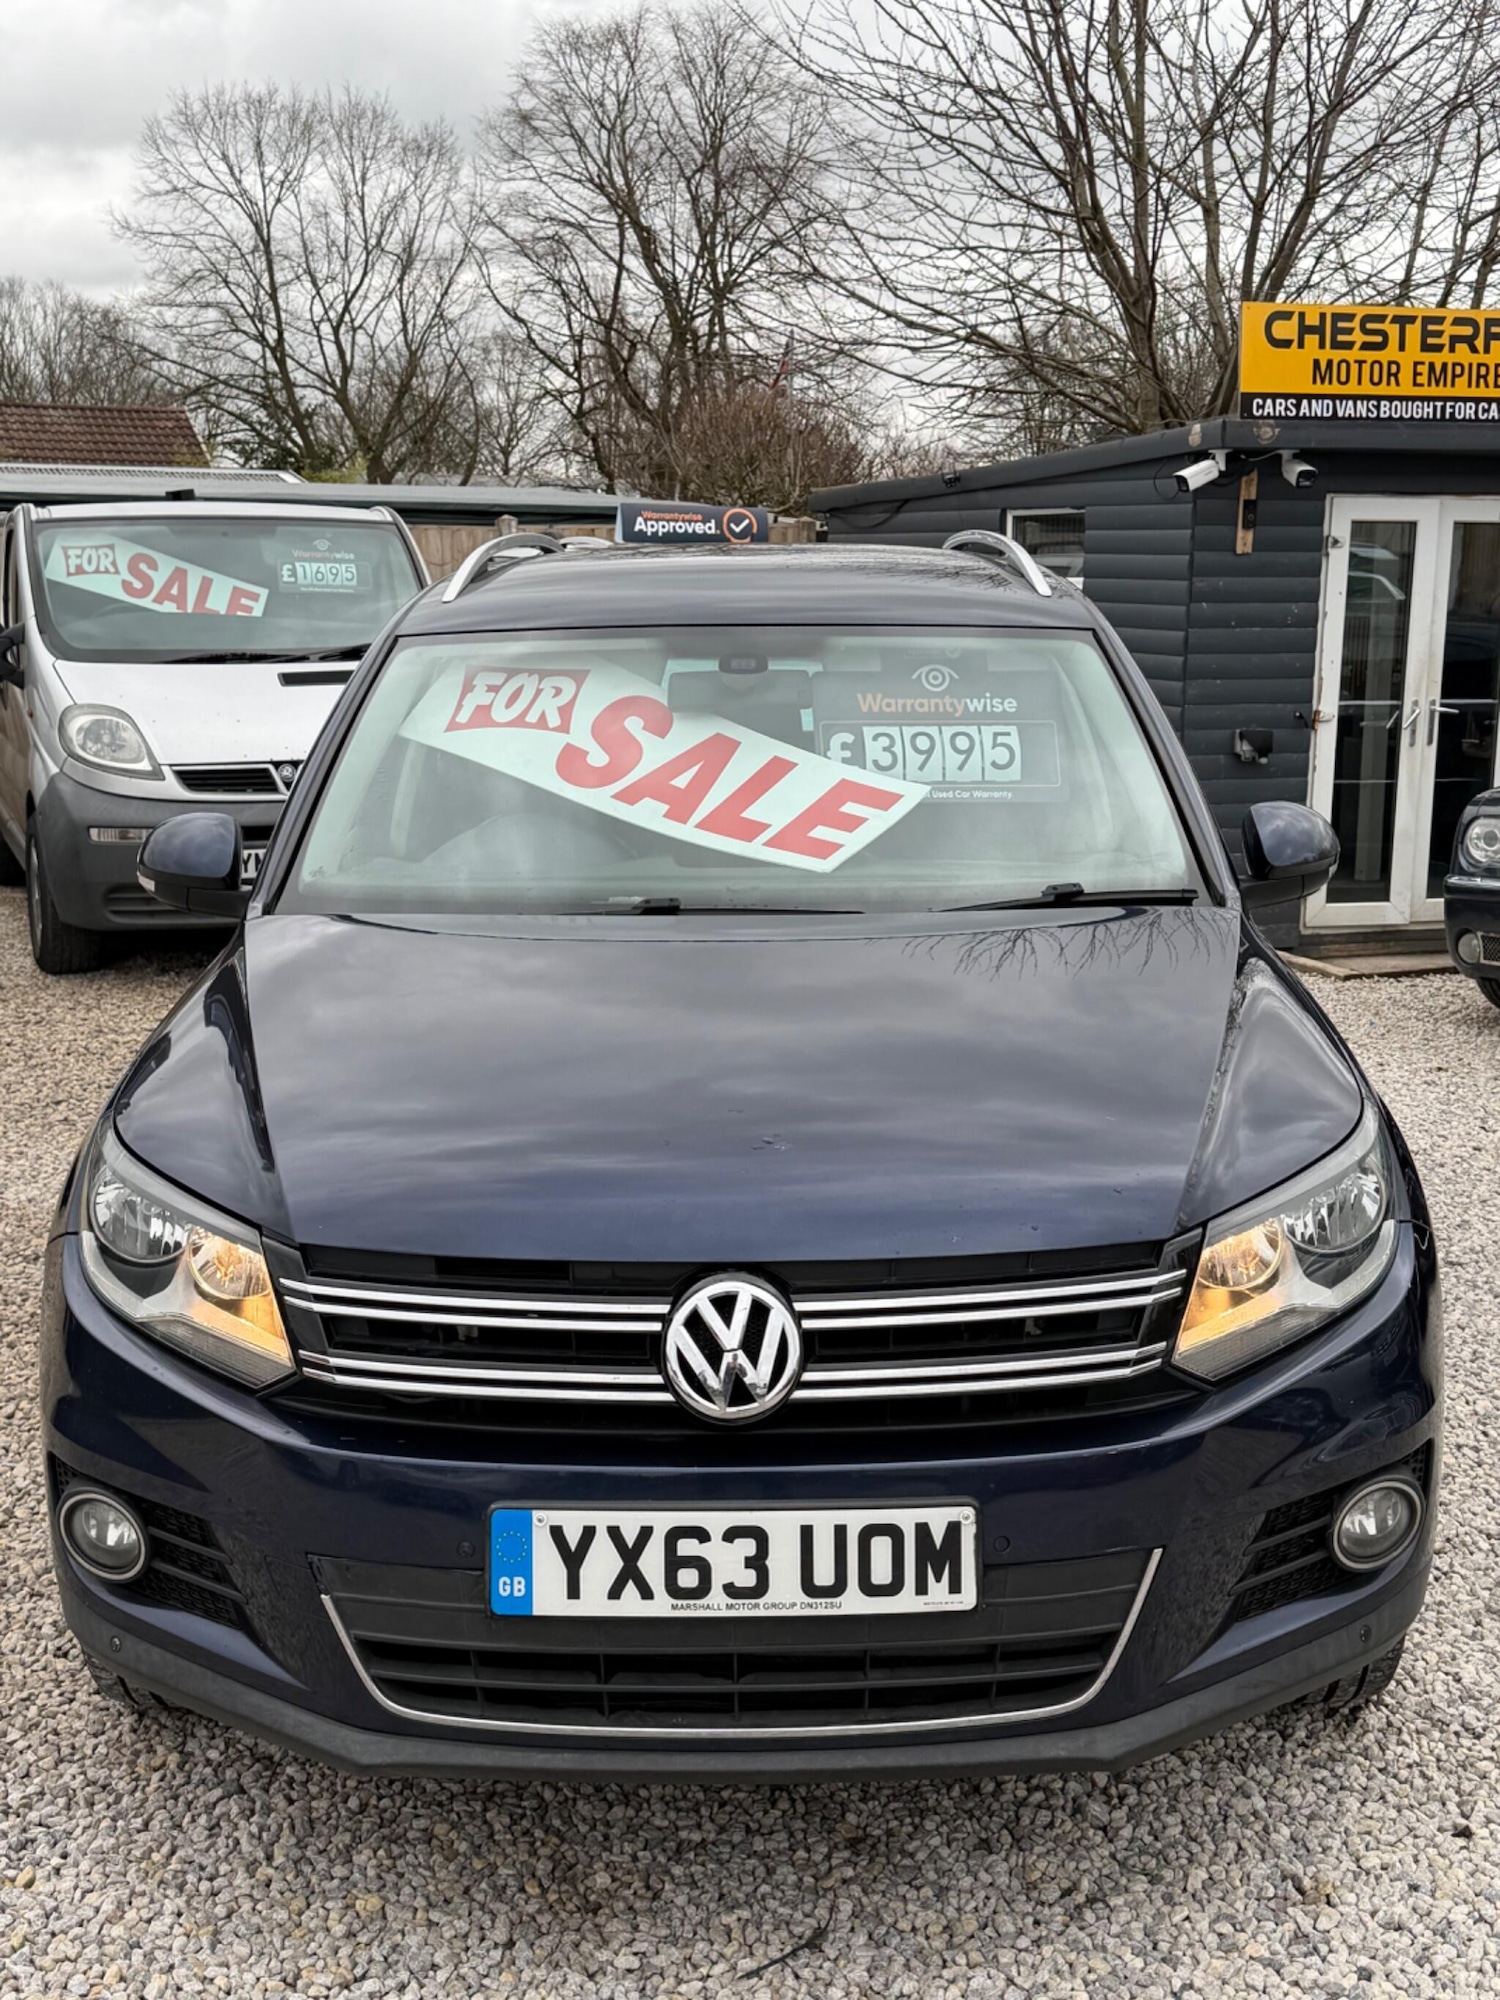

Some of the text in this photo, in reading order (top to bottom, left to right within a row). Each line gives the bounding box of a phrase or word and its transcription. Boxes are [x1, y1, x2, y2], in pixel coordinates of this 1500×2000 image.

[1312, 358, 1500, 389] MOTOR EMPIRE
[1252, 398, 1500, 420] CARS AND VANS BOUGHT FOR CA
[641, 510, 703, 522] Warrantywise
[65, 546, 262, 616] FOR SALE
[281, 563, 355, 583] £1695
[856, 692, 1018, 717] Warrantywise
[826, 730, 1017, 773] £3995
[455, 669, 905, 861] FOR SALE
[931, 789, 953, 799] Used
[955, 789, 970, 799] Car
[549, 1520, 963, 1601] YX63 UOM
[498, 1576, 527, 1597] GB
[671, 1602, 723, 1612] MARSHALL
[725, 1602, 761, 1611] MOTOR
[762, 1601, 798, 1611] GROUP
